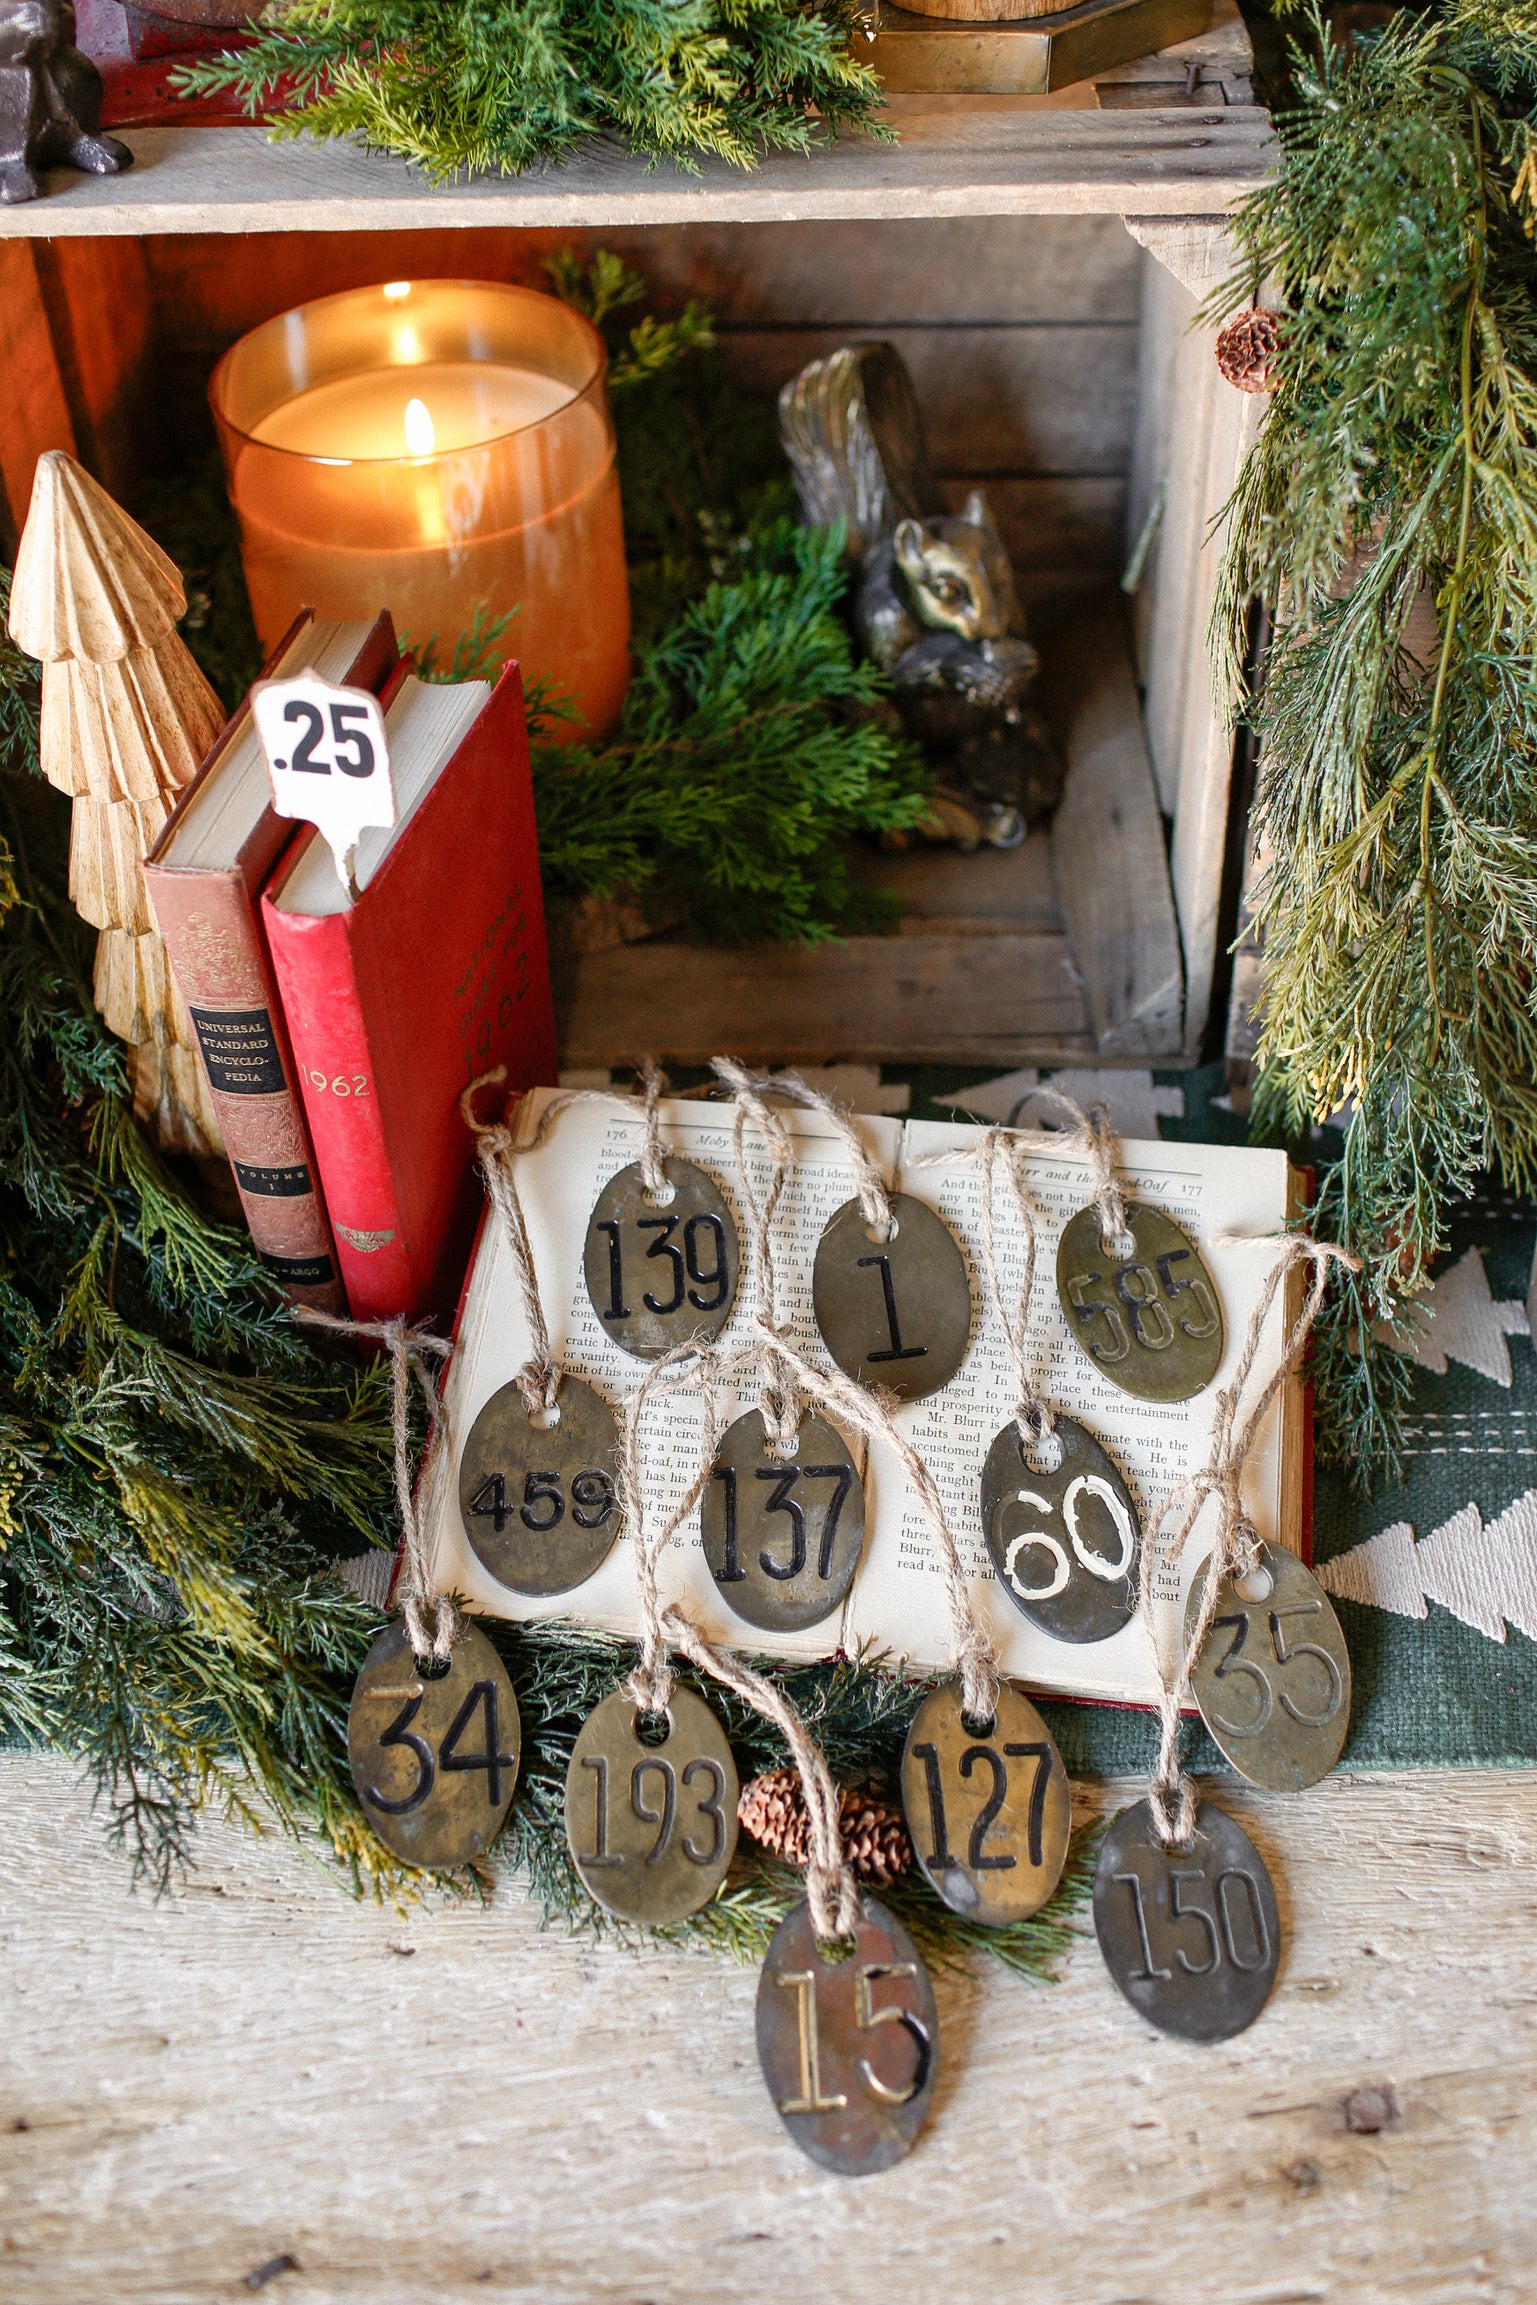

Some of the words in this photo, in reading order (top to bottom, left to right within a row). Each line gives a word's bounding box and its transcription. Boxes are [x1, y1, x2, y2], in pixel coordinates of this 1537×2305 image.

[273, 699, 375, 779] .25
[197, 1020, 265, 1034] UNIVERSAL
[201, 1037, 269, 1050] STANDARD
[208, 1053, 269, 1066] ENCYCLO-
[224, 1072, 262, 1082] PEDIA
[301, 1062, 370, 1097] 1962
[606, 1129, 627, 1140] 176
[695, 1135, 729, 1149] Moby
[240, 1168, 304, 1180] VOLUME
[598, 1161, 618, 1170] and
[786, 1180, 803, 1189] are
[807, 1182, 821, 1190] no
[750, 1161, 772, 1171] bird
[793, 1165, 824, 1177] broad
[1046, 1170, 1071, 1180] and
[1182, 1184, 1202, 1196] 177
[813, 1193, 826, 1203] he
[940, 1193, 961, 1204] any
[1035, 1203, 1053, 1214] the
[941, 1178, 965, 1189] And
[1046, 1191, 1063, 1201] not
[1174, 1207, 1201, 1217] men,
[773, 1214, 784, 1224] of
[939, 1205, 963, 1216] time
[1047, 1219, 1058, 1228] to
[968, 1222, 979, 1232] of
[803, 1233, 815, 1241] or
[1007, 1240, 1018, 1250] in
[790, 1241, 809, 1252] few
[596, 1213, 730, 1320] 139
[742, 1254, 753, 1262] to
[1034, 1271, 1053, 1282] has
[1033, 1284, 1045, 1295] in
[780, 1299, 801, 1309] and
[857, 1255, 928, 1362] 1
[1068, 1248, 1218, 1363] 585
[582, 1323, 599, 1333] He
[726, 1322, 744, 1331] the
[1037, 1314, 1052, 1325] up
[566, 1335, 599, 1348] cratic
[1048, 1340, 1063, 1350] all
[563, 1351, 577, 1359] or
[581, 1352, 620, 1365] vanity.
[975, 1346, 1006, 1358] place
[1049, 1354, 1069, 1364] Mr.
[561, 1363, 588, 1374] fault
[591, 1364, 602, 1375] of
[605, 1365, 622, 1376] his
[970, 1361, 983, 1369] as
[1030, 1366, 1068, 1380] proper
[1076, 1369, 1094, 1381] for
[603, 1381, 616, 1390] or
[994, 1376, 1008, 1386] In
[1051, 1382, 1082, 1394] place
[1092, 1386, 1122, 1398] these
[646, 1397, 674, 1409] luck.
[915, 1398, 937, 1408] and
[942, 1401, 1003, 1416] prosperity
[986, 1389, 998, 1399] to
[1059, 1398, 1071, 1408] to
[1078, 1399, 1097, 1411] the
[1105, 1404, 1189, 1422] entertainment
[927, 1411, 947, 1423] Mr.
[953, 1414, 986, 1428] Blurr
[990, 1419, 1000, 1429] is
[1136, 1435, 1163, 1447] with
[1169, 1439, 1188, 1451] the
[657, 1443, 665, 1451] a
[911, 1425, 949, 1439] habits
[958, 1432, 981, 1443] and
[1150, 1453, 1167, 1464] He
[1178, 1456, 1188, 1466] is
[677, 1458, 688, 1469] in
[911, 1441, 980, 1457] accustomed
[1024, 1453, 1049, 1466] that
[1127, 1467, 1160, 1479] teach
[645, 1470, 666, 1481] has
[670, 1472, 687, 1483] his
[935, 1473, 975, 1487] taught
[467, 1468, 615, 1532] 459
[711, 1464, 852, 1582] 137
[902, 1513, 926, 1525] fore
[992, 1475, 1134, 1600] 60
[901, 1528, 932, 1541] three
[1160, 1560, 1180, 1572] Mr.
[897, 1559, 924, 1571] read
[980, 1567, 996, 1580] all
[900, 1542, 935, 1558] Blurr,
[1158, 1574, 1181, 1587] had
[1207, 1600, 1342, 1738] 35
[363, 1680, 514, 1814] 34
[579, 1756, 726, 1867] 193
[912, 1743, 1053, 1870] 127
[1112, 1866, 1272, 1981] 150
[776, 1963, 932, 2113] 15
